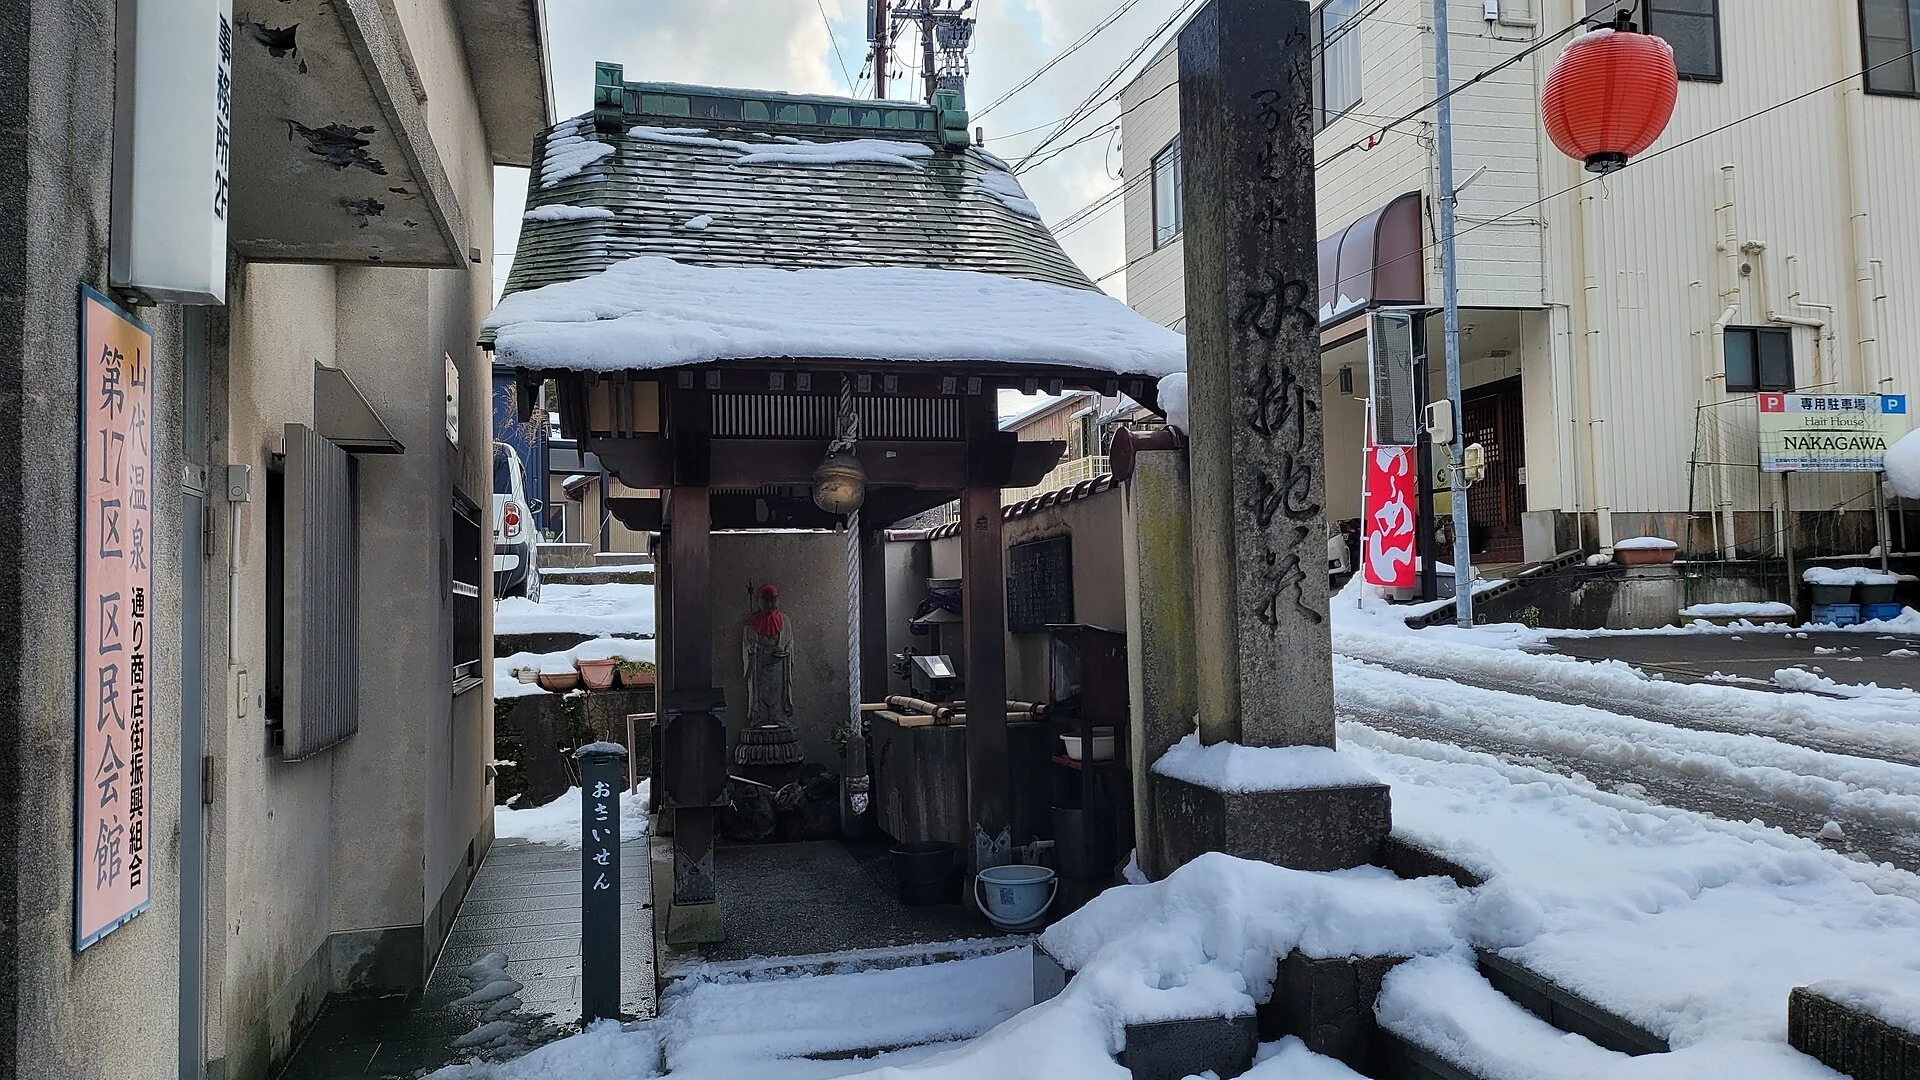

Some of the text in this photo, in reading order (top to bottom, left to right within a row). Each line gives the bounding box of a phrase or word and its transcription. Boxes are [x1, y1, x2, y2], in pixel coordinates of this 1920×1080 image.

[1801, 398, 1866, 411] 専用駐車場
[1804, 417, 1864, 427] Hair House
[1784, 436, 1888, 450] NAKAGAWA
[591, 781, 611, 891] おさいせん
